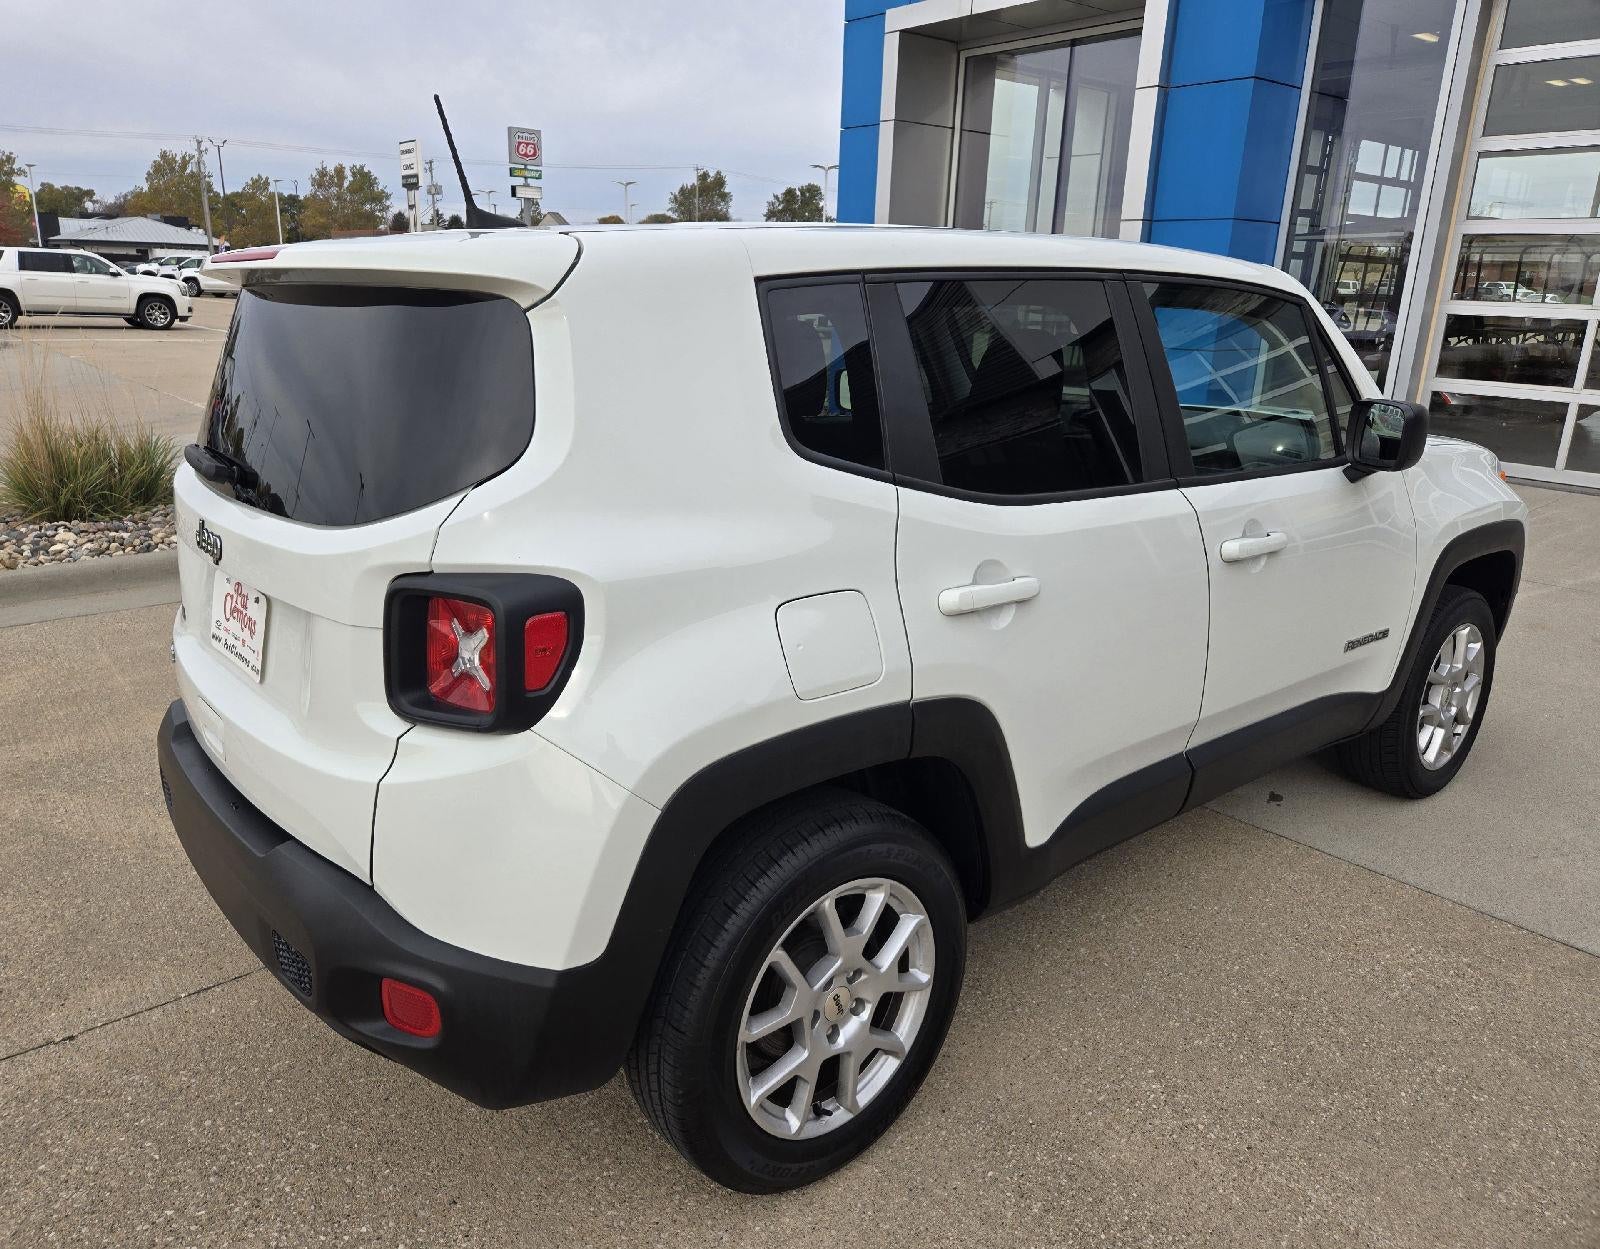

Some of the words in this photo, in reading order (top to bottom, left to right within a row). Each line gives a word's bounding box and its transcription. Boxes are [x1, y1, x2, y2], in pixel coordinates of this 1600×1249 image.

[519, 143, 534, 156] 66
[196, 519, 222, 565] Jeep
[234, 581, 249, 611] Pat
[223, 592, 257, 640] Clemons
[1343, 627, 1390, 653] RENEGADE
[832, 993, 845, 1016] Jeep
